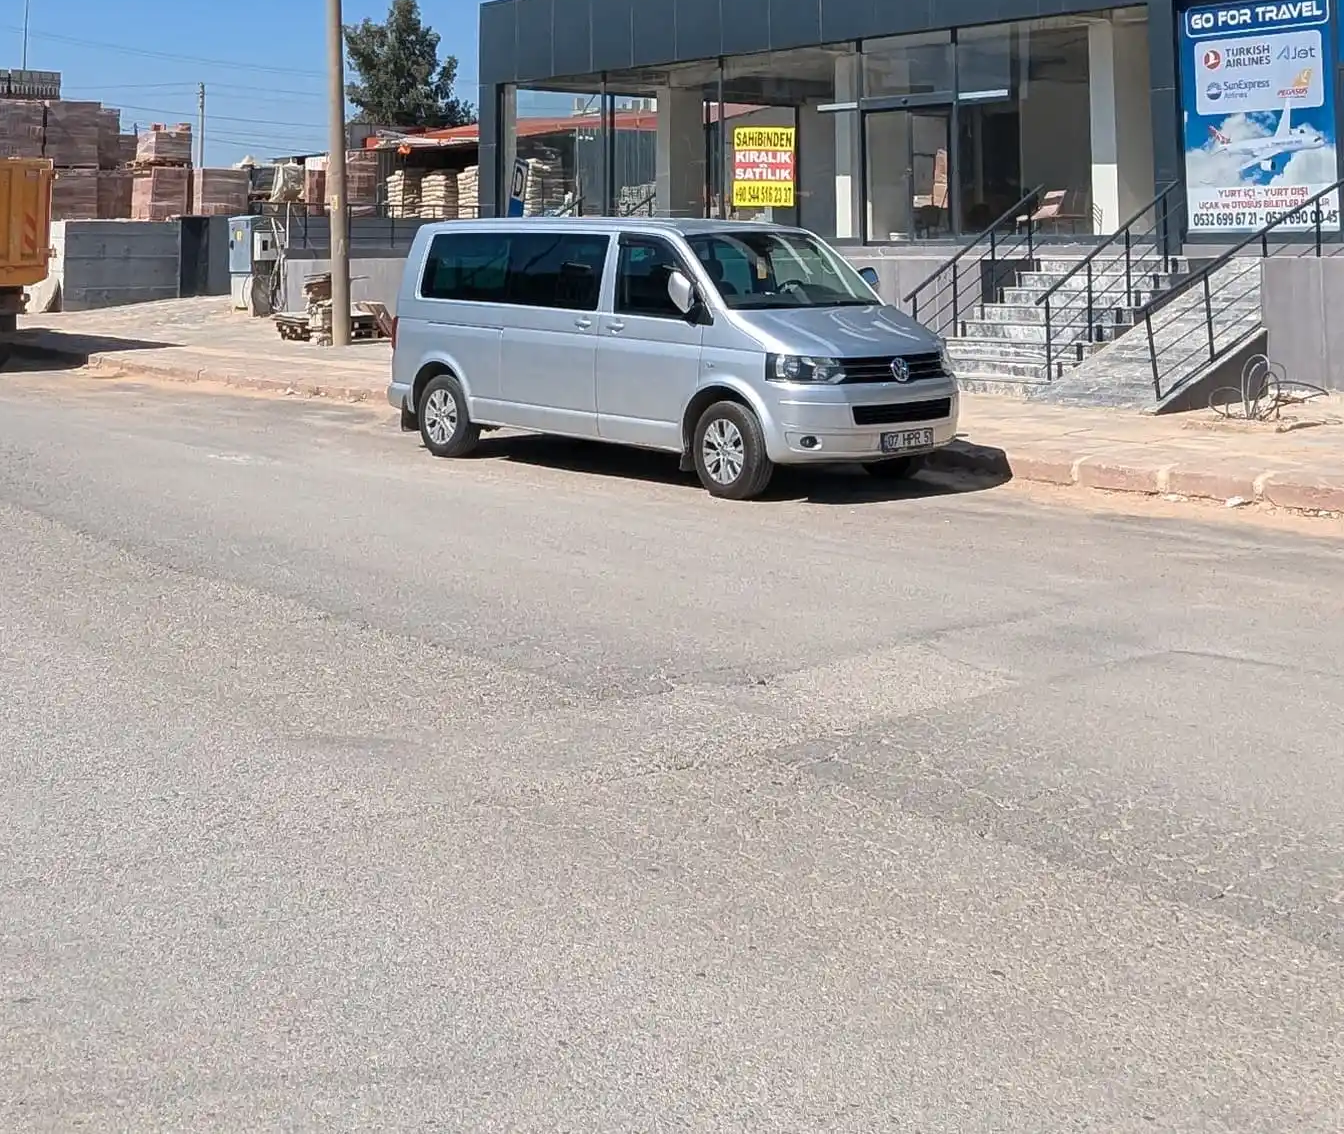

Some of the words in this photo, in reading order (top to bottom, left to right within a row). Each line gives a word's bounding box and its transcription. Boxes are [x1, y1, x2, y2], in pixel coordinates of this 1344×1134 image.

[1191, 13, 1214, 29] GO
[1217, 9, 1252, 27] FOR
[1255, 0, 1323, 22] TRAVEL
[1225, 44, 1271, 59] TURKISH
[1225, 55, 1271, 68] AIRLINES
[1223, 78, 1271, 91] SunExpress
[736, 131, 793, 147] SAHİBİNDEN
[736, 168, 791, 180] SATILIK
[1218, 189, 1242, 198] YURT
[1263, 188, 1289, 197] YURT
[1193, 213, 1215, 226] 0532
[1216, 212, 1234, 226] 699
[1235, 212, 1246, 226] 67
